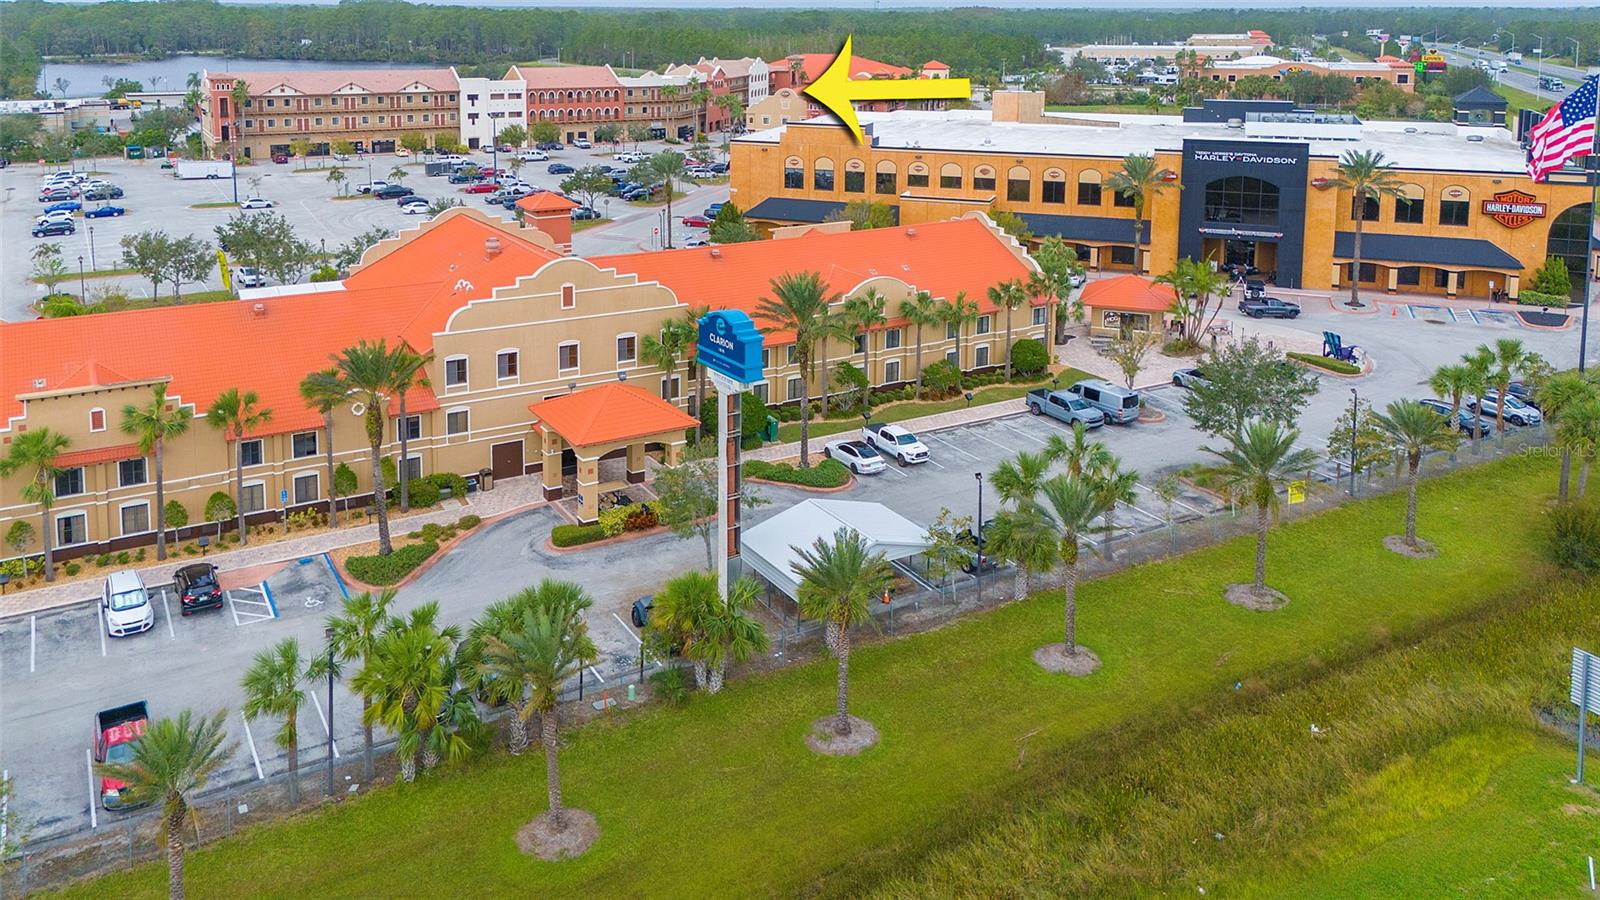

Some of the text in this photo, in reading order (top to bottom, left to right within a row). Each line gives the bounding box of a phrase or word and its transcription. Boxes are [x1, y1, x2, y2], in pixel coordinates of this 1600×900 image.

[1501, 194, 1530, 204] MOTOR
[1487, 203, 1543, 214] HARLEY-DAVIDSON
[709, 333, 734, 350] CLARION
